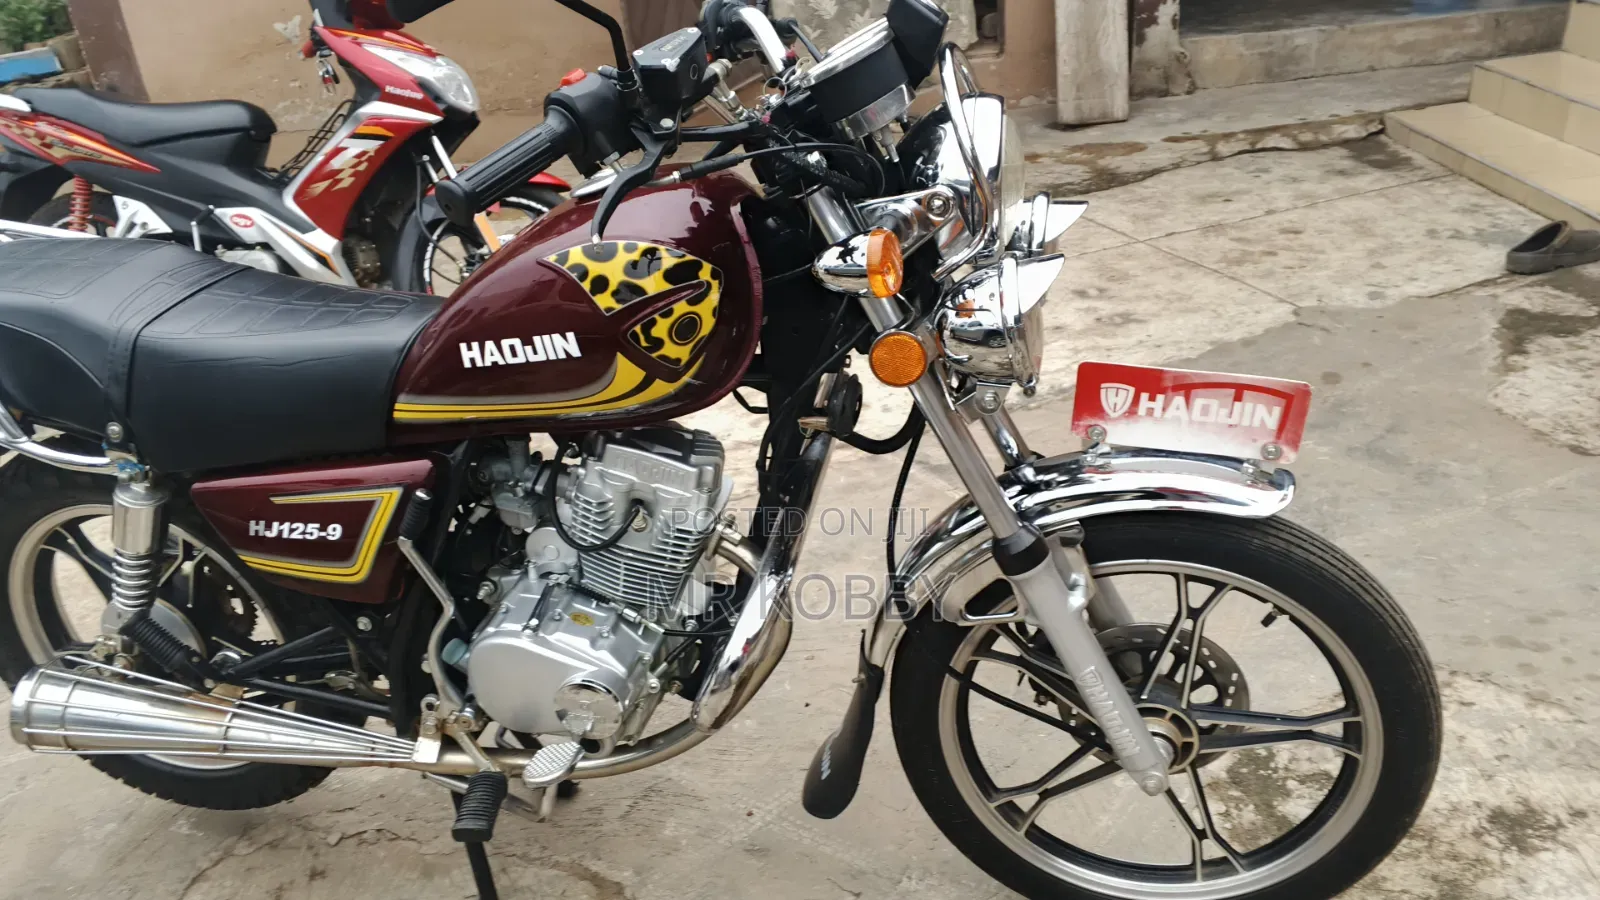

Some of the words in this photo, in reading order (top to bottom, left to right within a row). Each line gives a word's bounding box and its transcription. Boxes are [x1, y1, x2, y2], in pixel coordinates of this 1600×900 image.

[459, 331, 582, 369] HAOJIN
[1137, 391, 1281, 431] HAOJIN
[248, 520, 343, 541] HJ125-9
